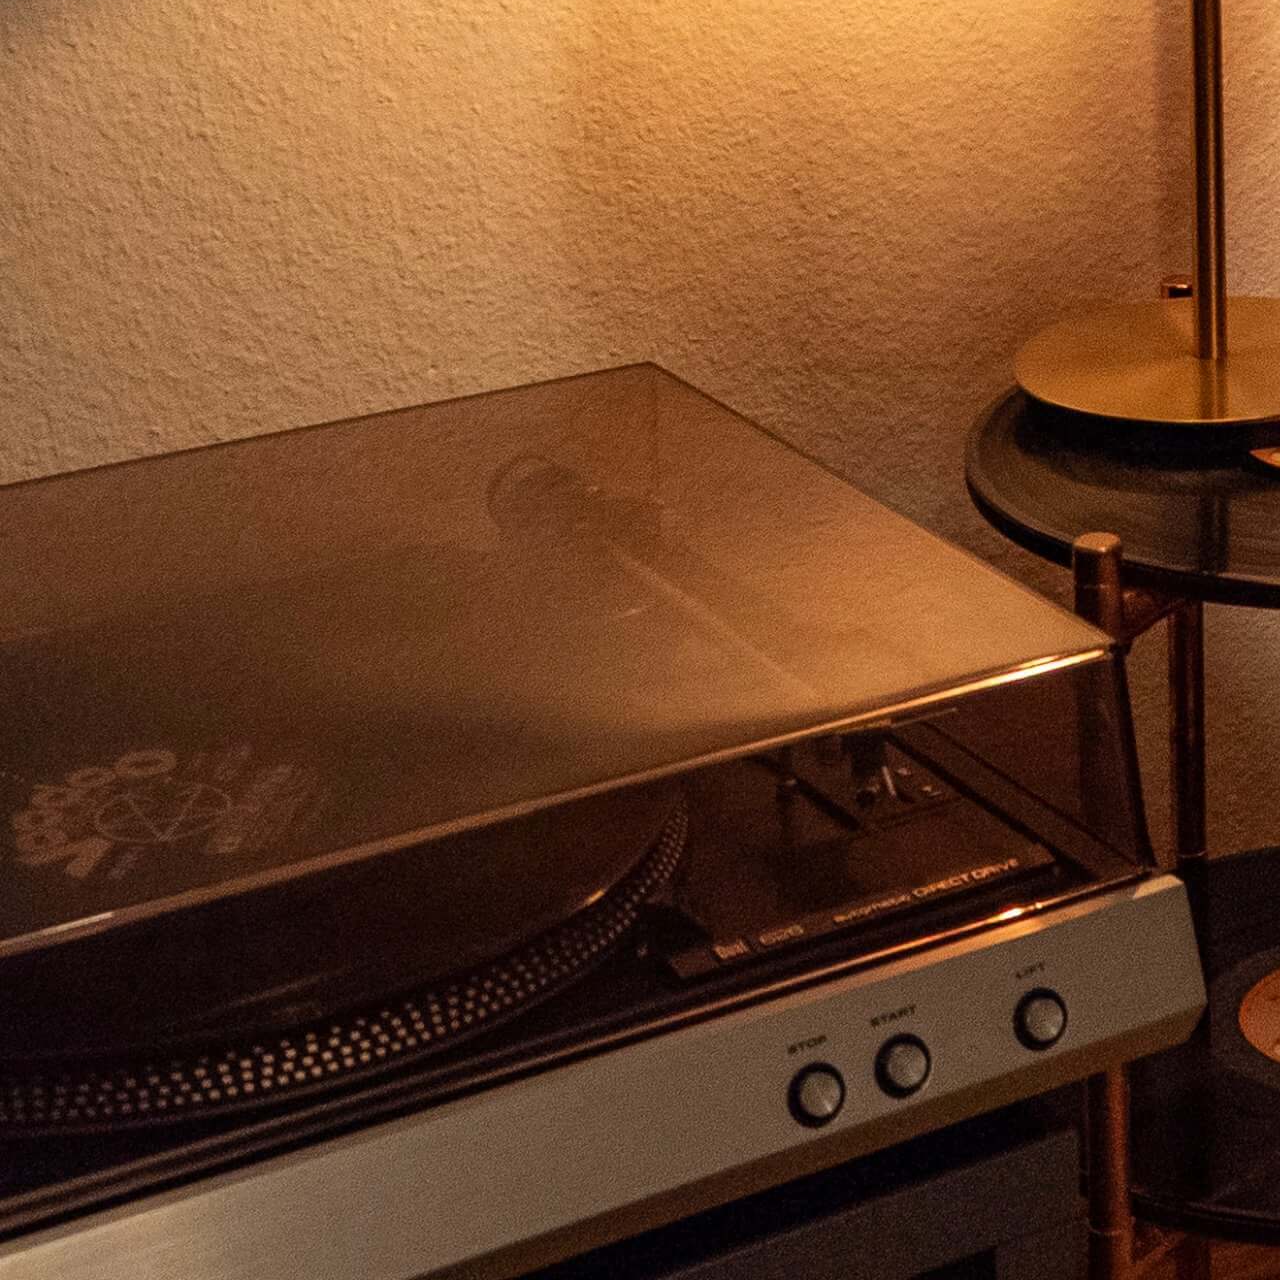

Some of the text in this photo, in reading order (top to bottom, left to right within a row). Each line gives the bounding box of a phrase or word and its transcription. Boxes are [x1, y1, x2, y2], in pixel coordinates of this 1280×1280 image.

[1015, 962, 1046, 979] LIFT
[870, 1004, 917, 1028] START
[788, 1034, 828, 1055] STOP
